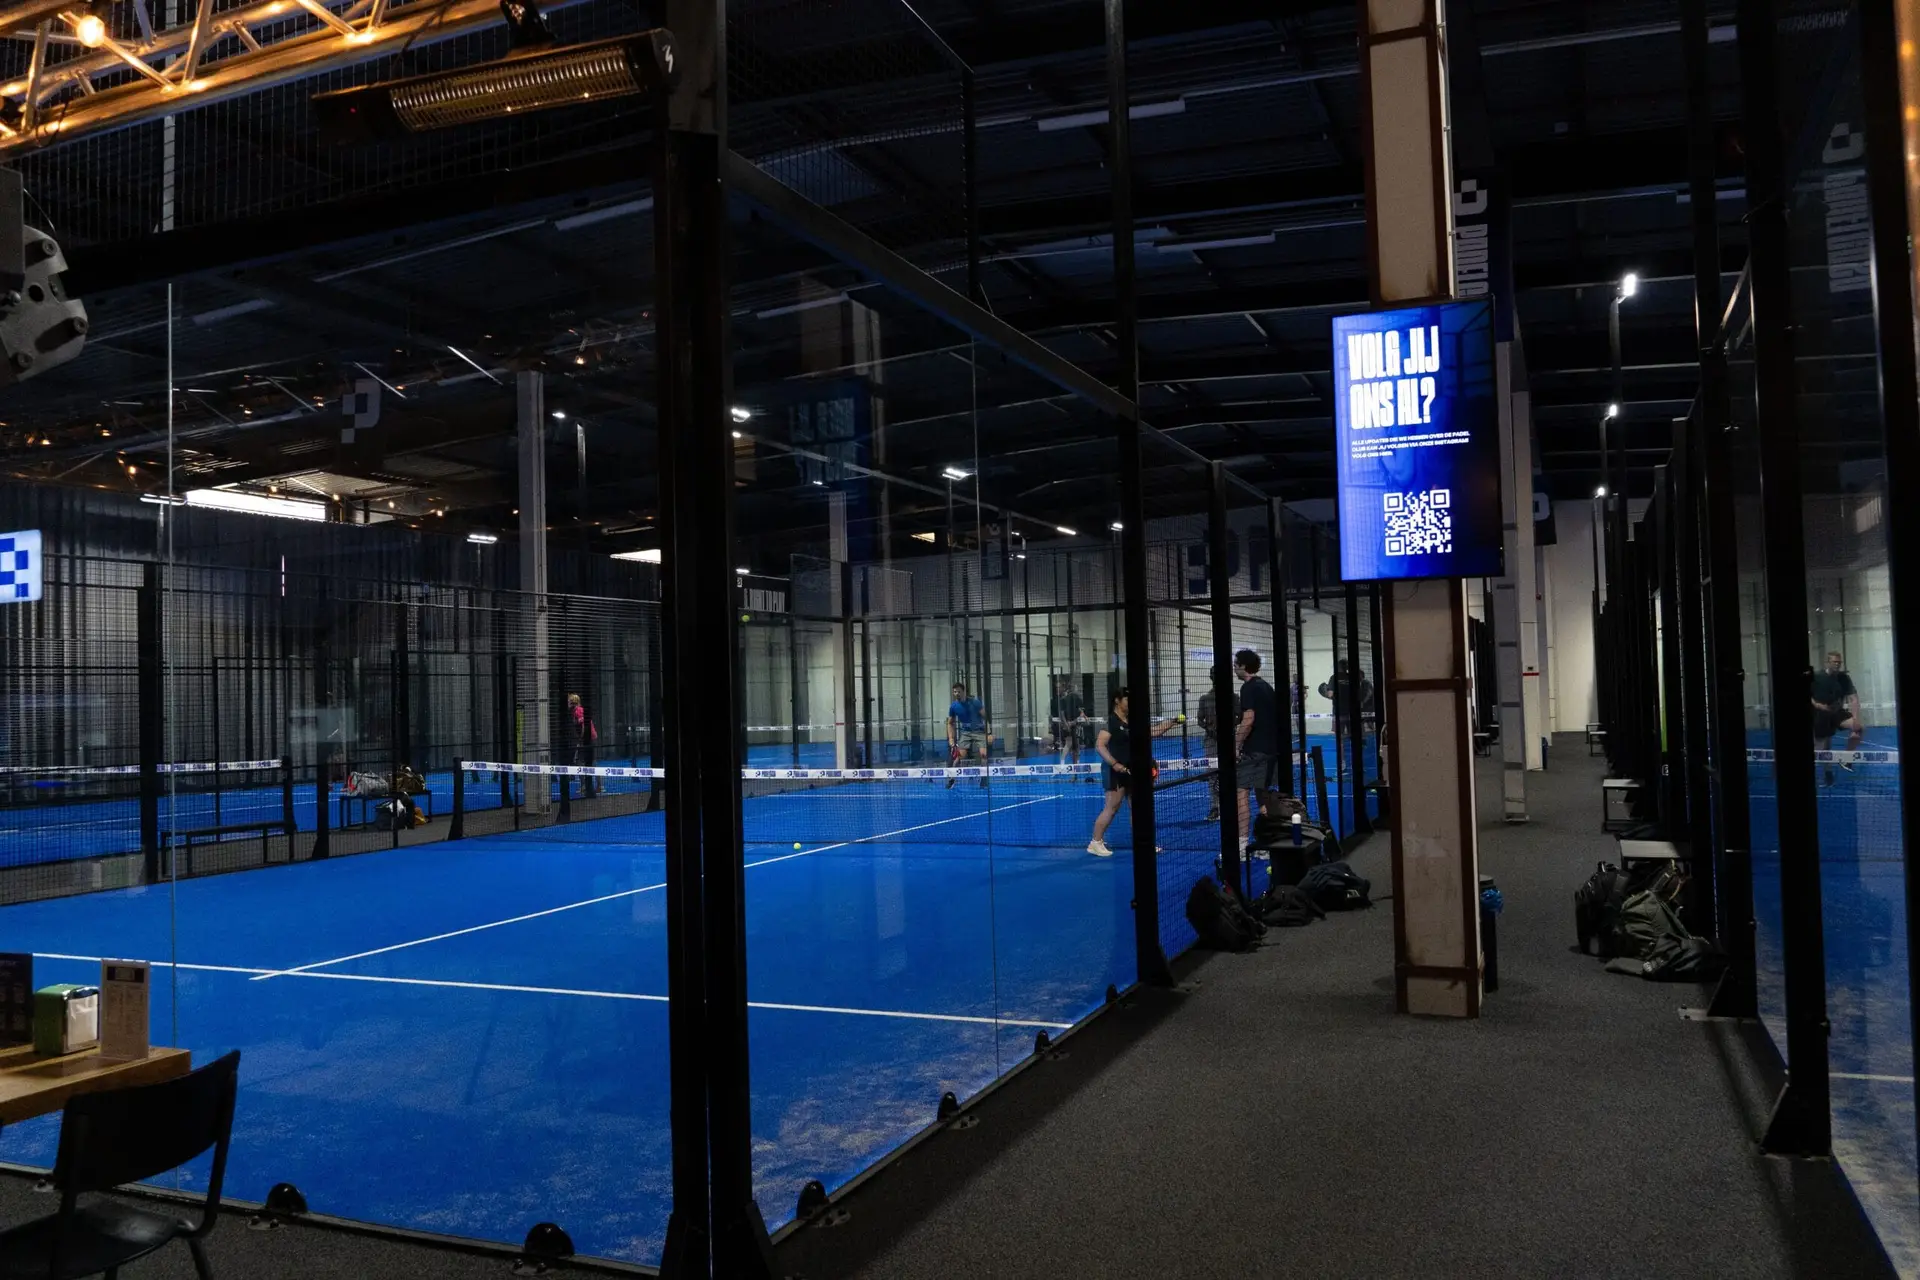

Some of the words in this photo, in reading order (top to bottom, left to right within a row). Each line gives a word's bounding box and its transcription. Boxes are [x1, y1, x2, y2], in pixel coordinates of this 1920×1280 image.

[1347, 330, 1401, 380] VOLG
[1403, 325, 1440, 375] JIJ
[1350, 381, 1395, 429] ONS
[1397, 377, 1436, 426] AL?
[1364, 437, 1389, 445] UPDATES
